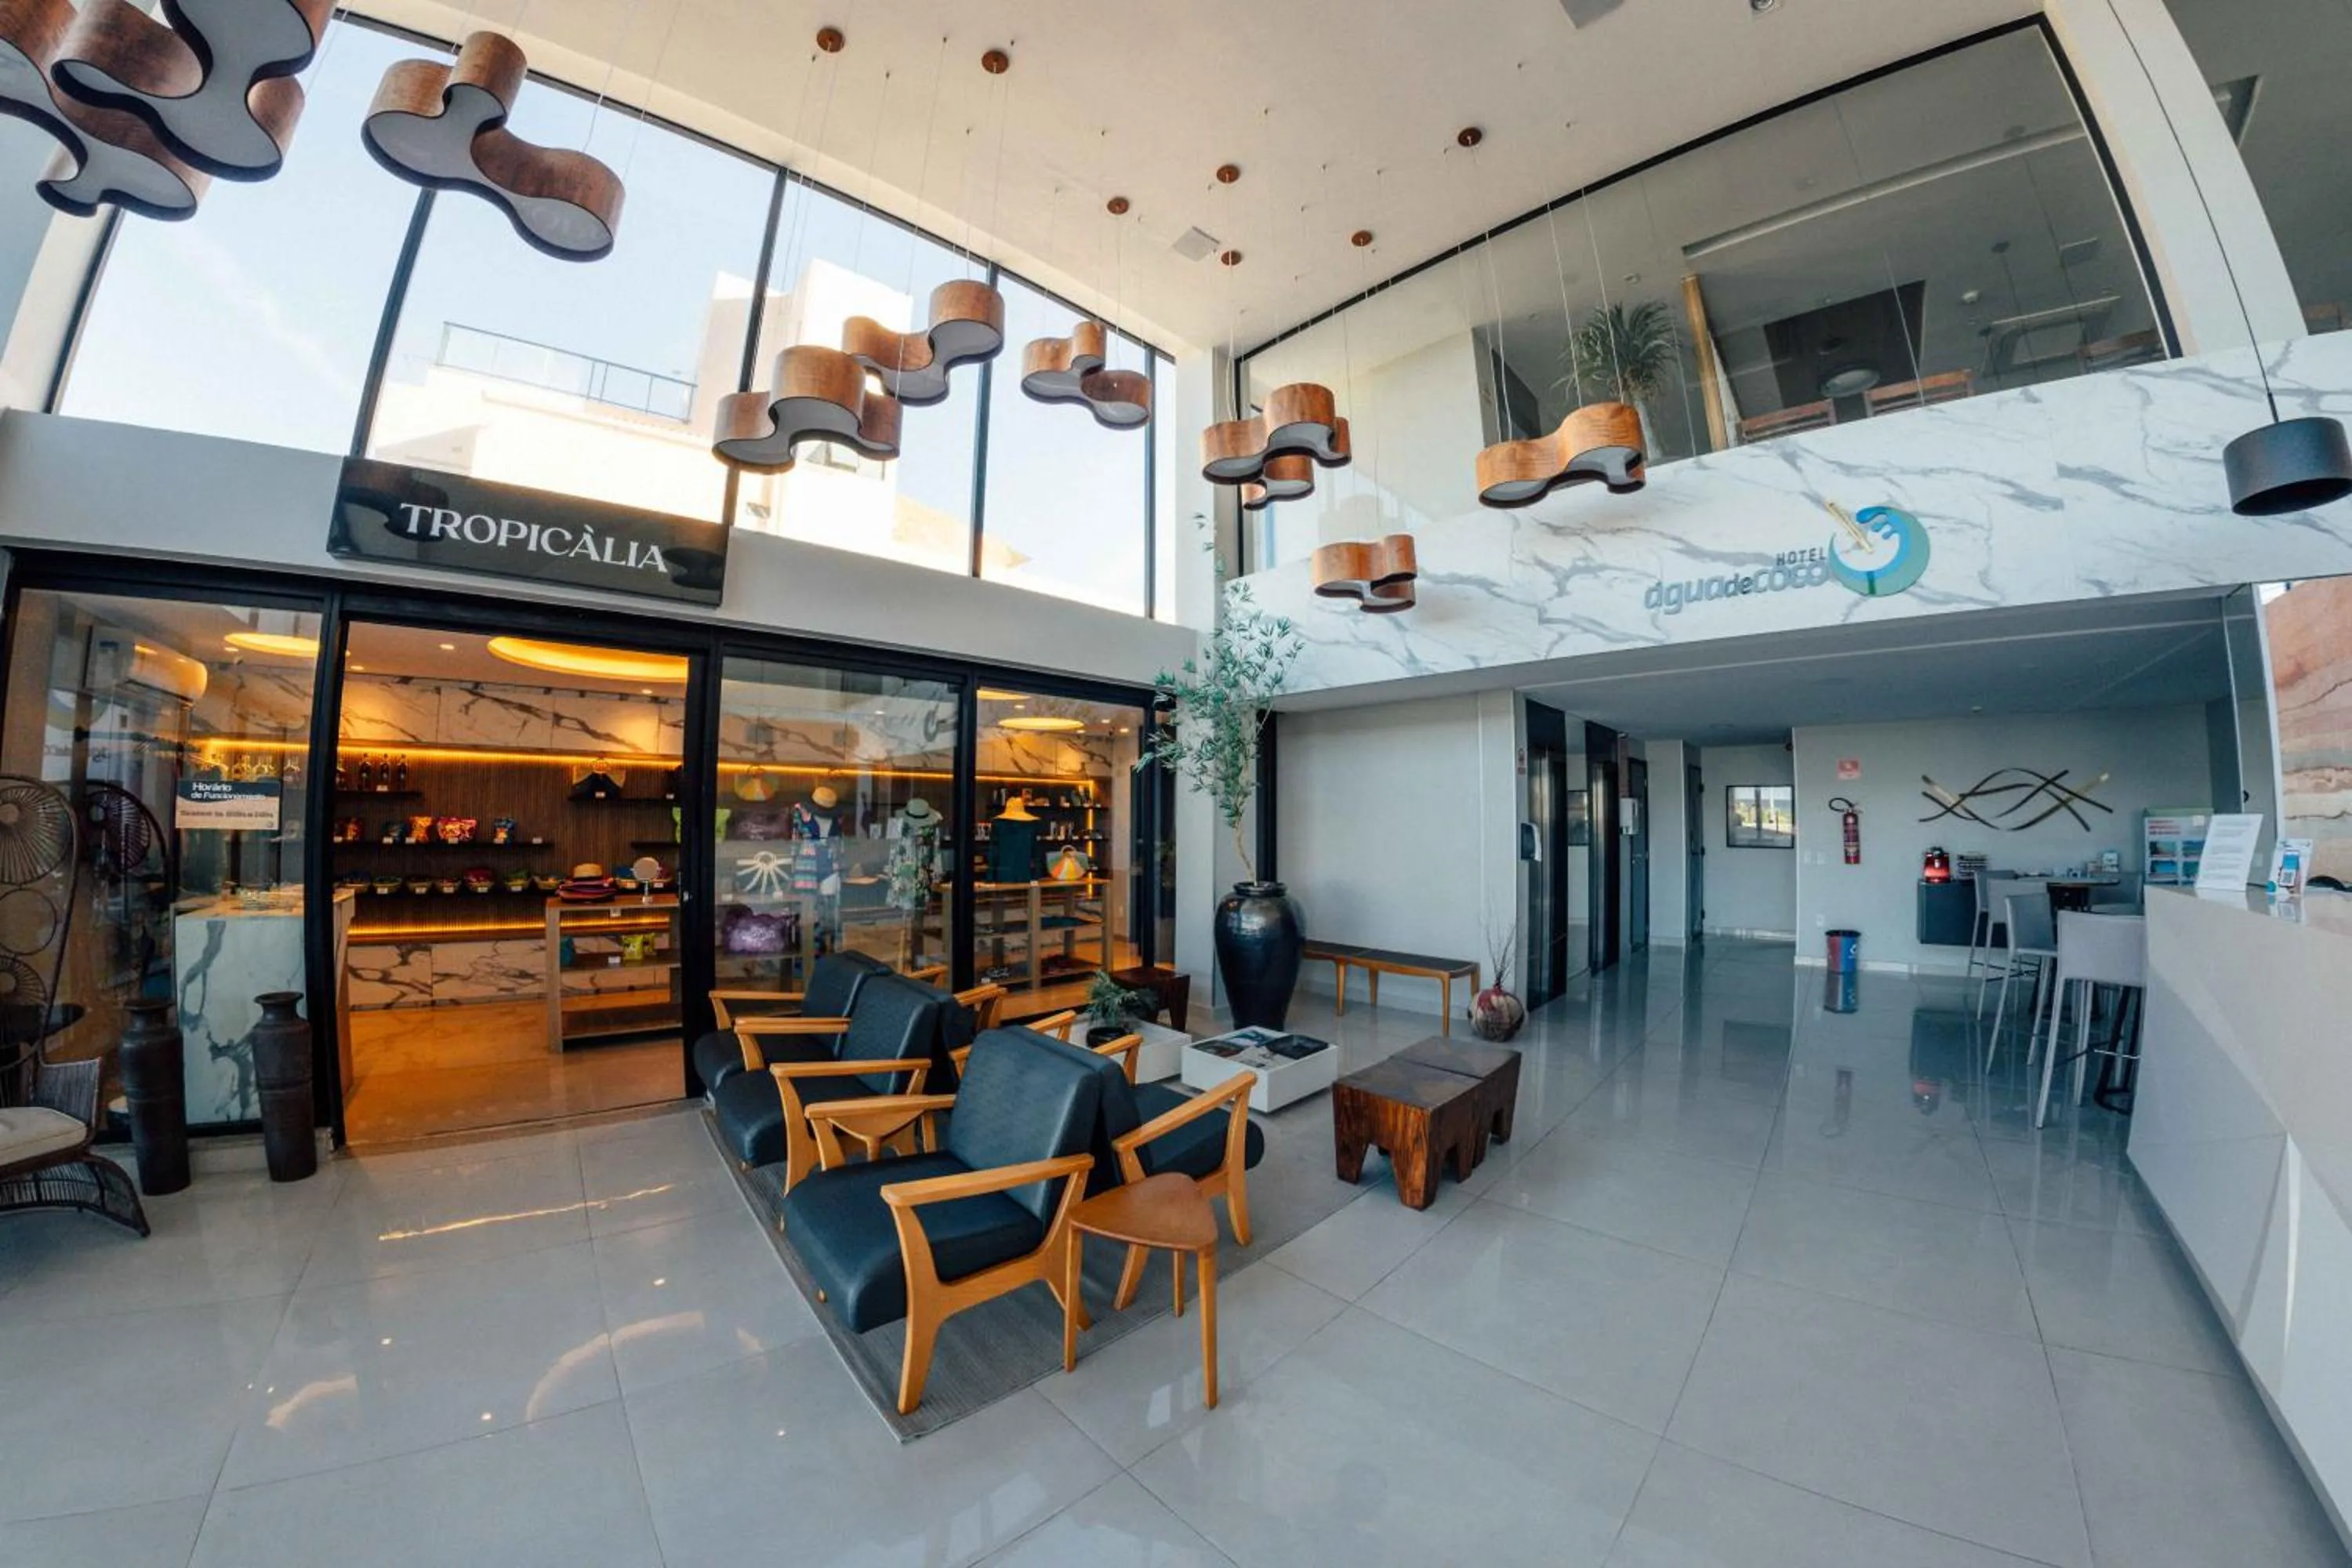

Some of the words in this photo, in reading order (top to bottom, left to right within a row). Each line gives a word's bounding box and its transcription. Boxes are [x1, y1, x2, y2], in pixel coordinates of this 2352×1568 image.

[399, 502, 668, 573] TROPICÀLIA
[1776, 546, 1827, 566] HOTEL
[192, 782, 232, 792] Horário
